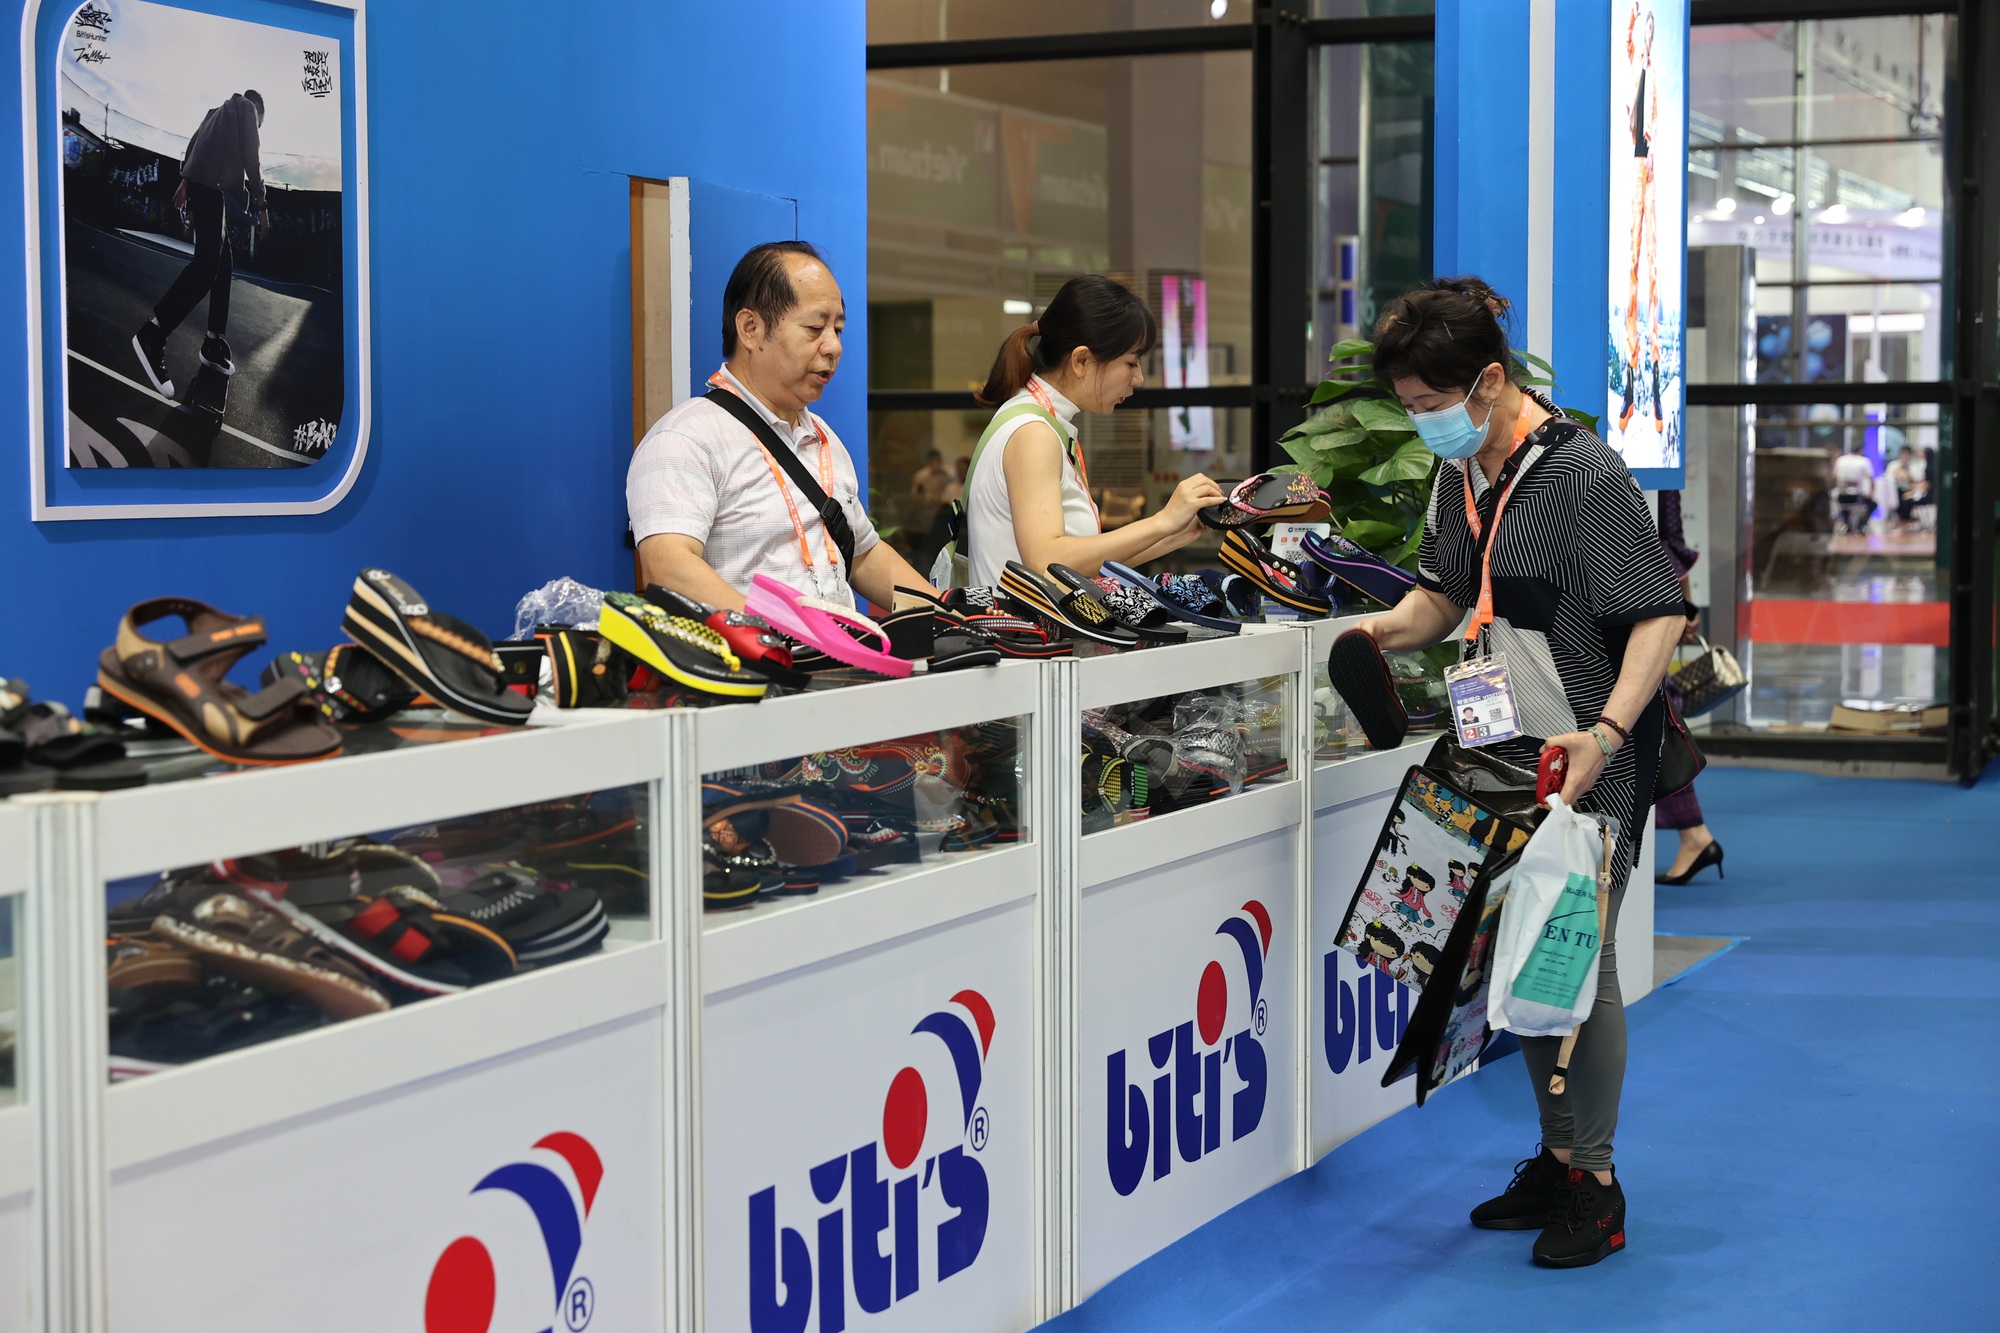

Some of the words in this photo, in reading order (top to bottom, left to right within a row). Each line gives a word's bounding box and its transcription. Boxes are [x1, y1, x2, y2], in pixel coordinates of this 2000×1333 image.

[303, 51, 329, 66] PROUDLY
[303, 64, 320, 78] MADE
[301, 76, 333, 92] VIETNAM
[1466, 729, 1475, 739] 2
[1324, 950, 1409, 1074] biti
[1107, 961, 1267, 1196] biti's
